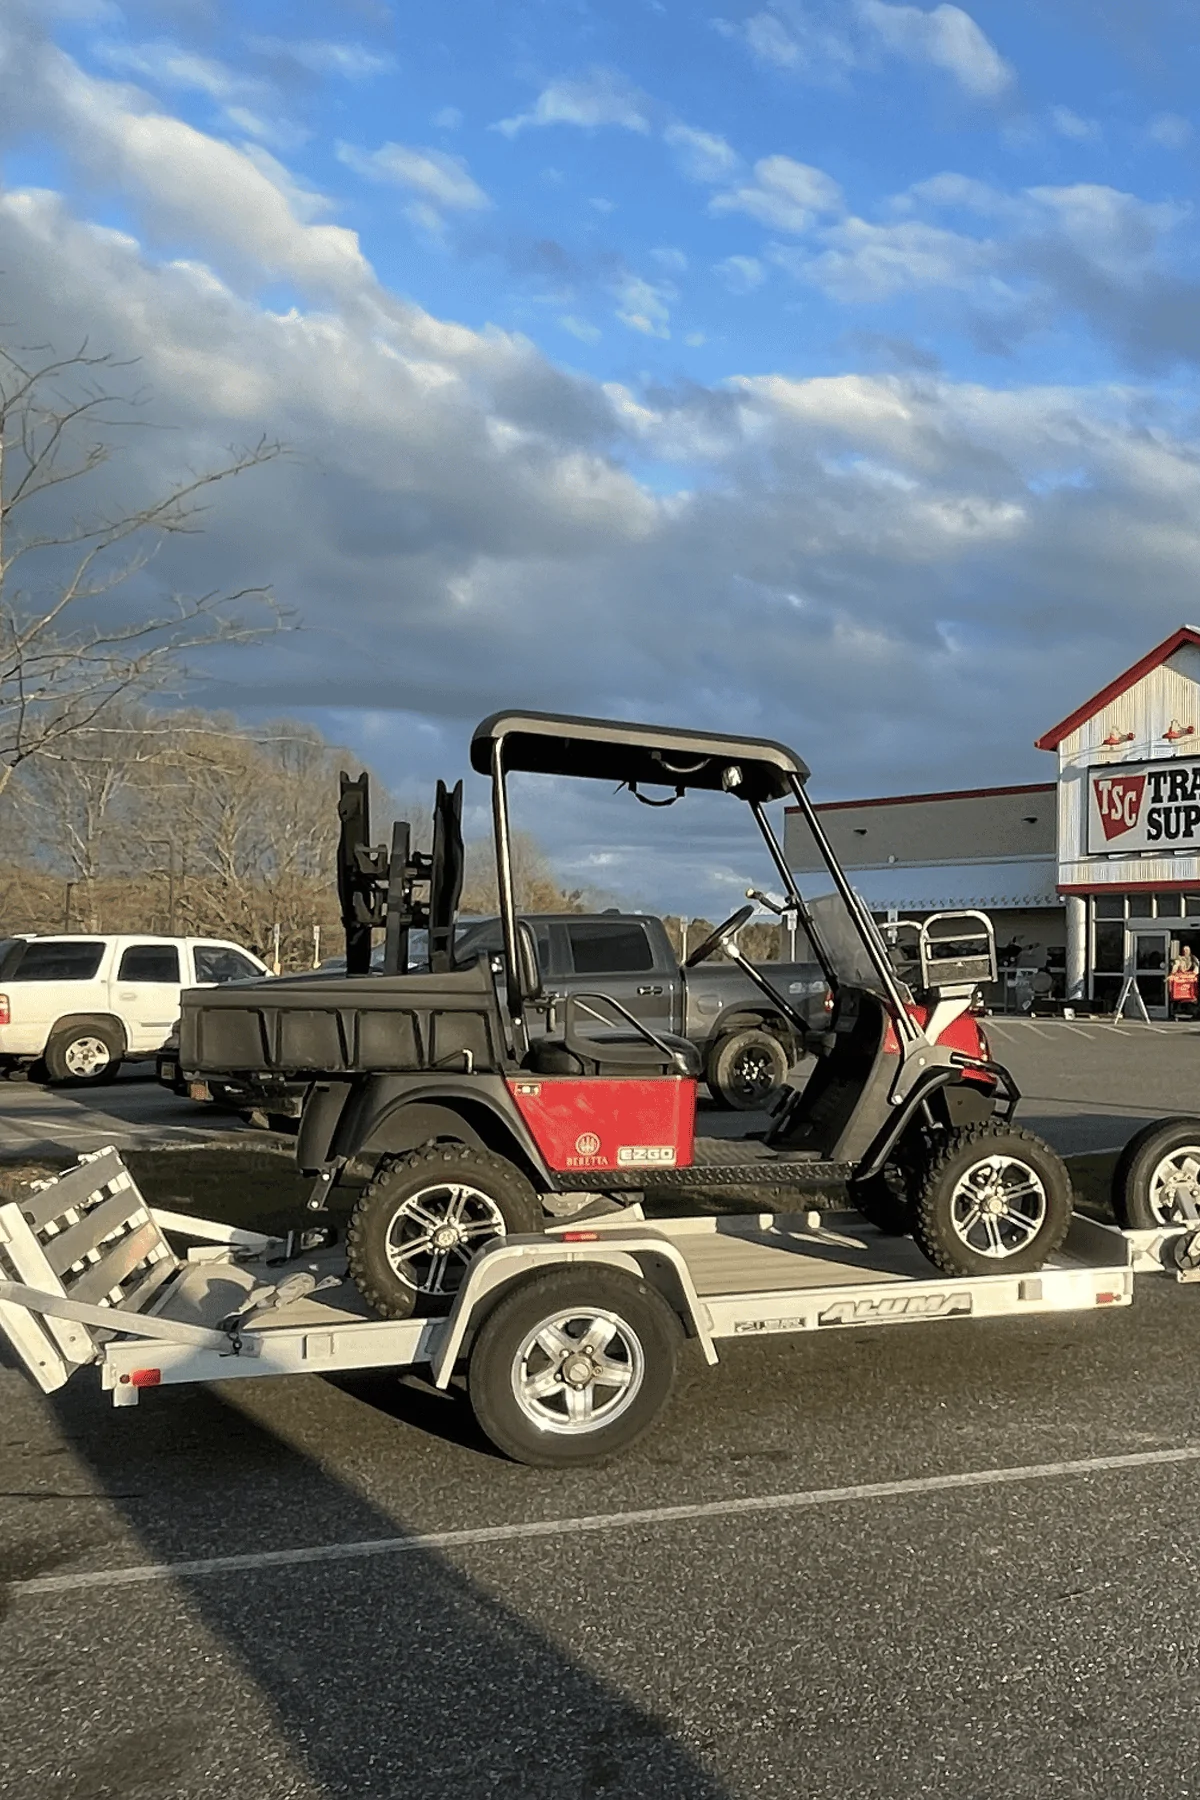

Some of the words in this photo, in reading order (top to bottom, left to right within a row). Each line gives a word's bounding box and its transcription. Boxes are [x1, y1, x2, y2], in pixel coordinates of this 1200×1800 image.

[1098, 780, 1137, 827] TSC
[566, 1156, 609, 1167] BERETTA
[619, 1147, 675, 1161] EZGO
[820, 1292, 972, 1324] ALUMA
